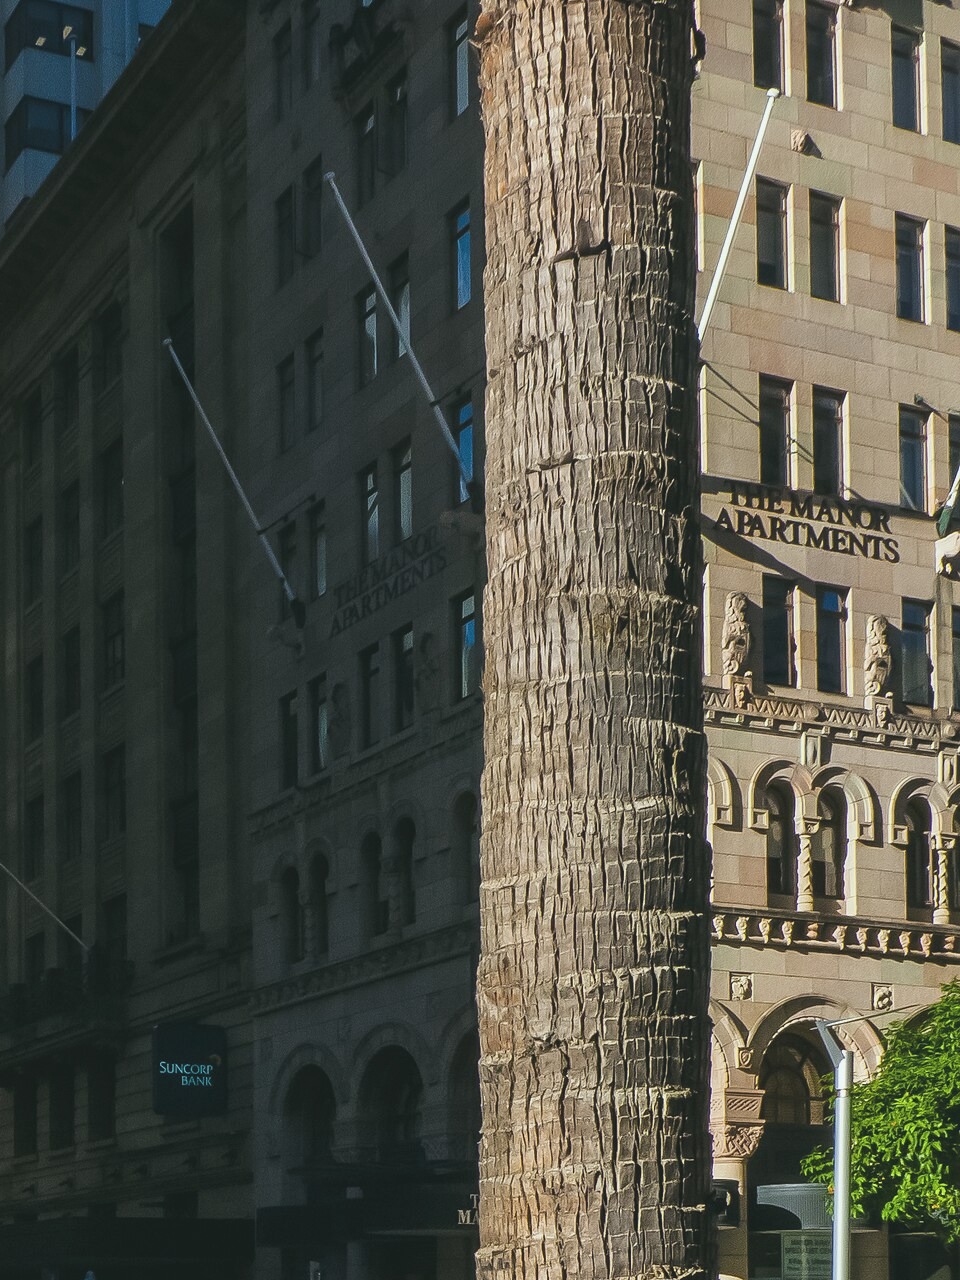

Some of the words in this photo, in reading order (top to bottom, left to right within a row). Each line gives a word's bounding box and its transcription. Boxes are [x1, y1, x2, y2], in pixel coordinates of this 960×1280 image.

[730, 484, 784, 514] THE
[790, 491, 893, 535] MANOR
[713, 507, 901, 564] APARTMENTS
[159, 1061, 213, 1075] SUNCORP
[181, 1075, 212, 1086] BANK
